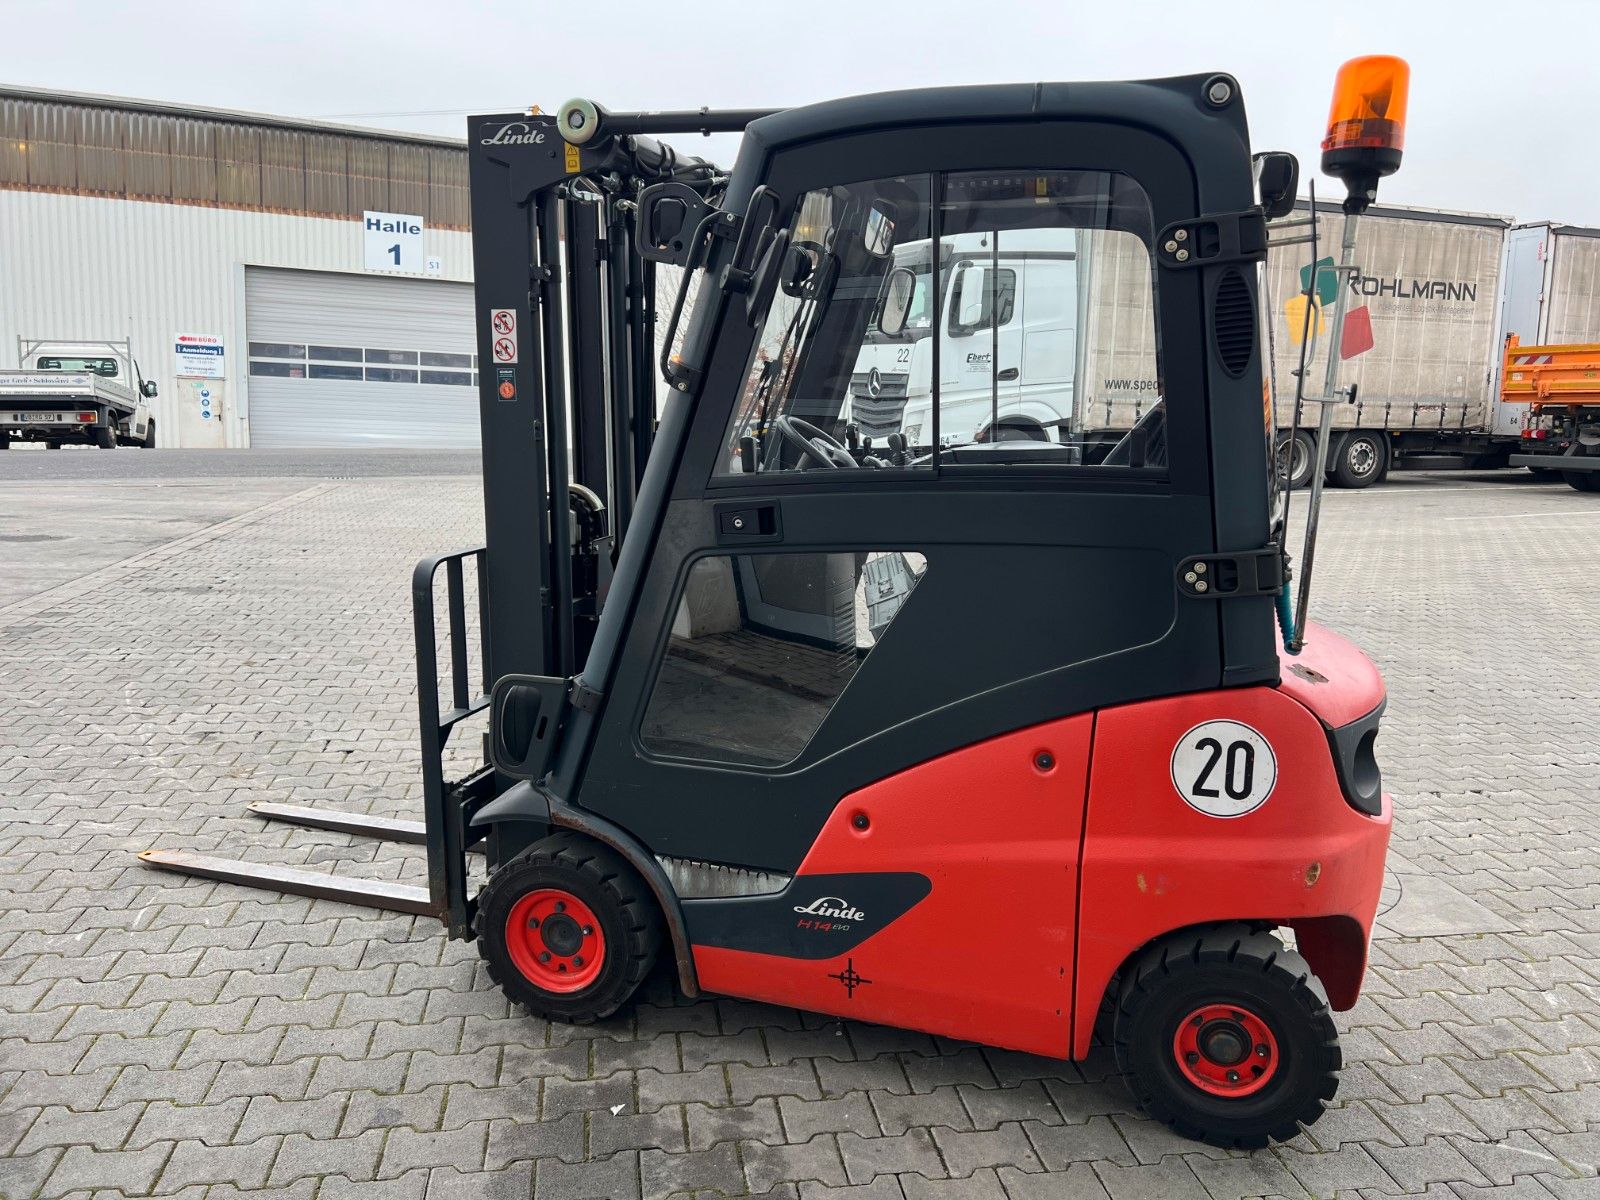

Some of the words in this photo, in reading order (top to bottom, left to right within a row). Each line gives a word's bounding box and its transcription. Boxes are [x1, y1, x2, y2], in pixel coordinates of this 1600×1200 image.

[480, 122, 545, 145] Linde
[366, 218, 421, 235] Halle
[387, 244, 401, 266] 1
[182, 346, 218, 356] Anmeldung
[897, 348, 910, 363] 22
[966, 352, 992, 364] Ebert
[1192, 737, 1255, 800] 20
[793, 896, 865, 921] Linde
[797, 919, 832, 932] H14
